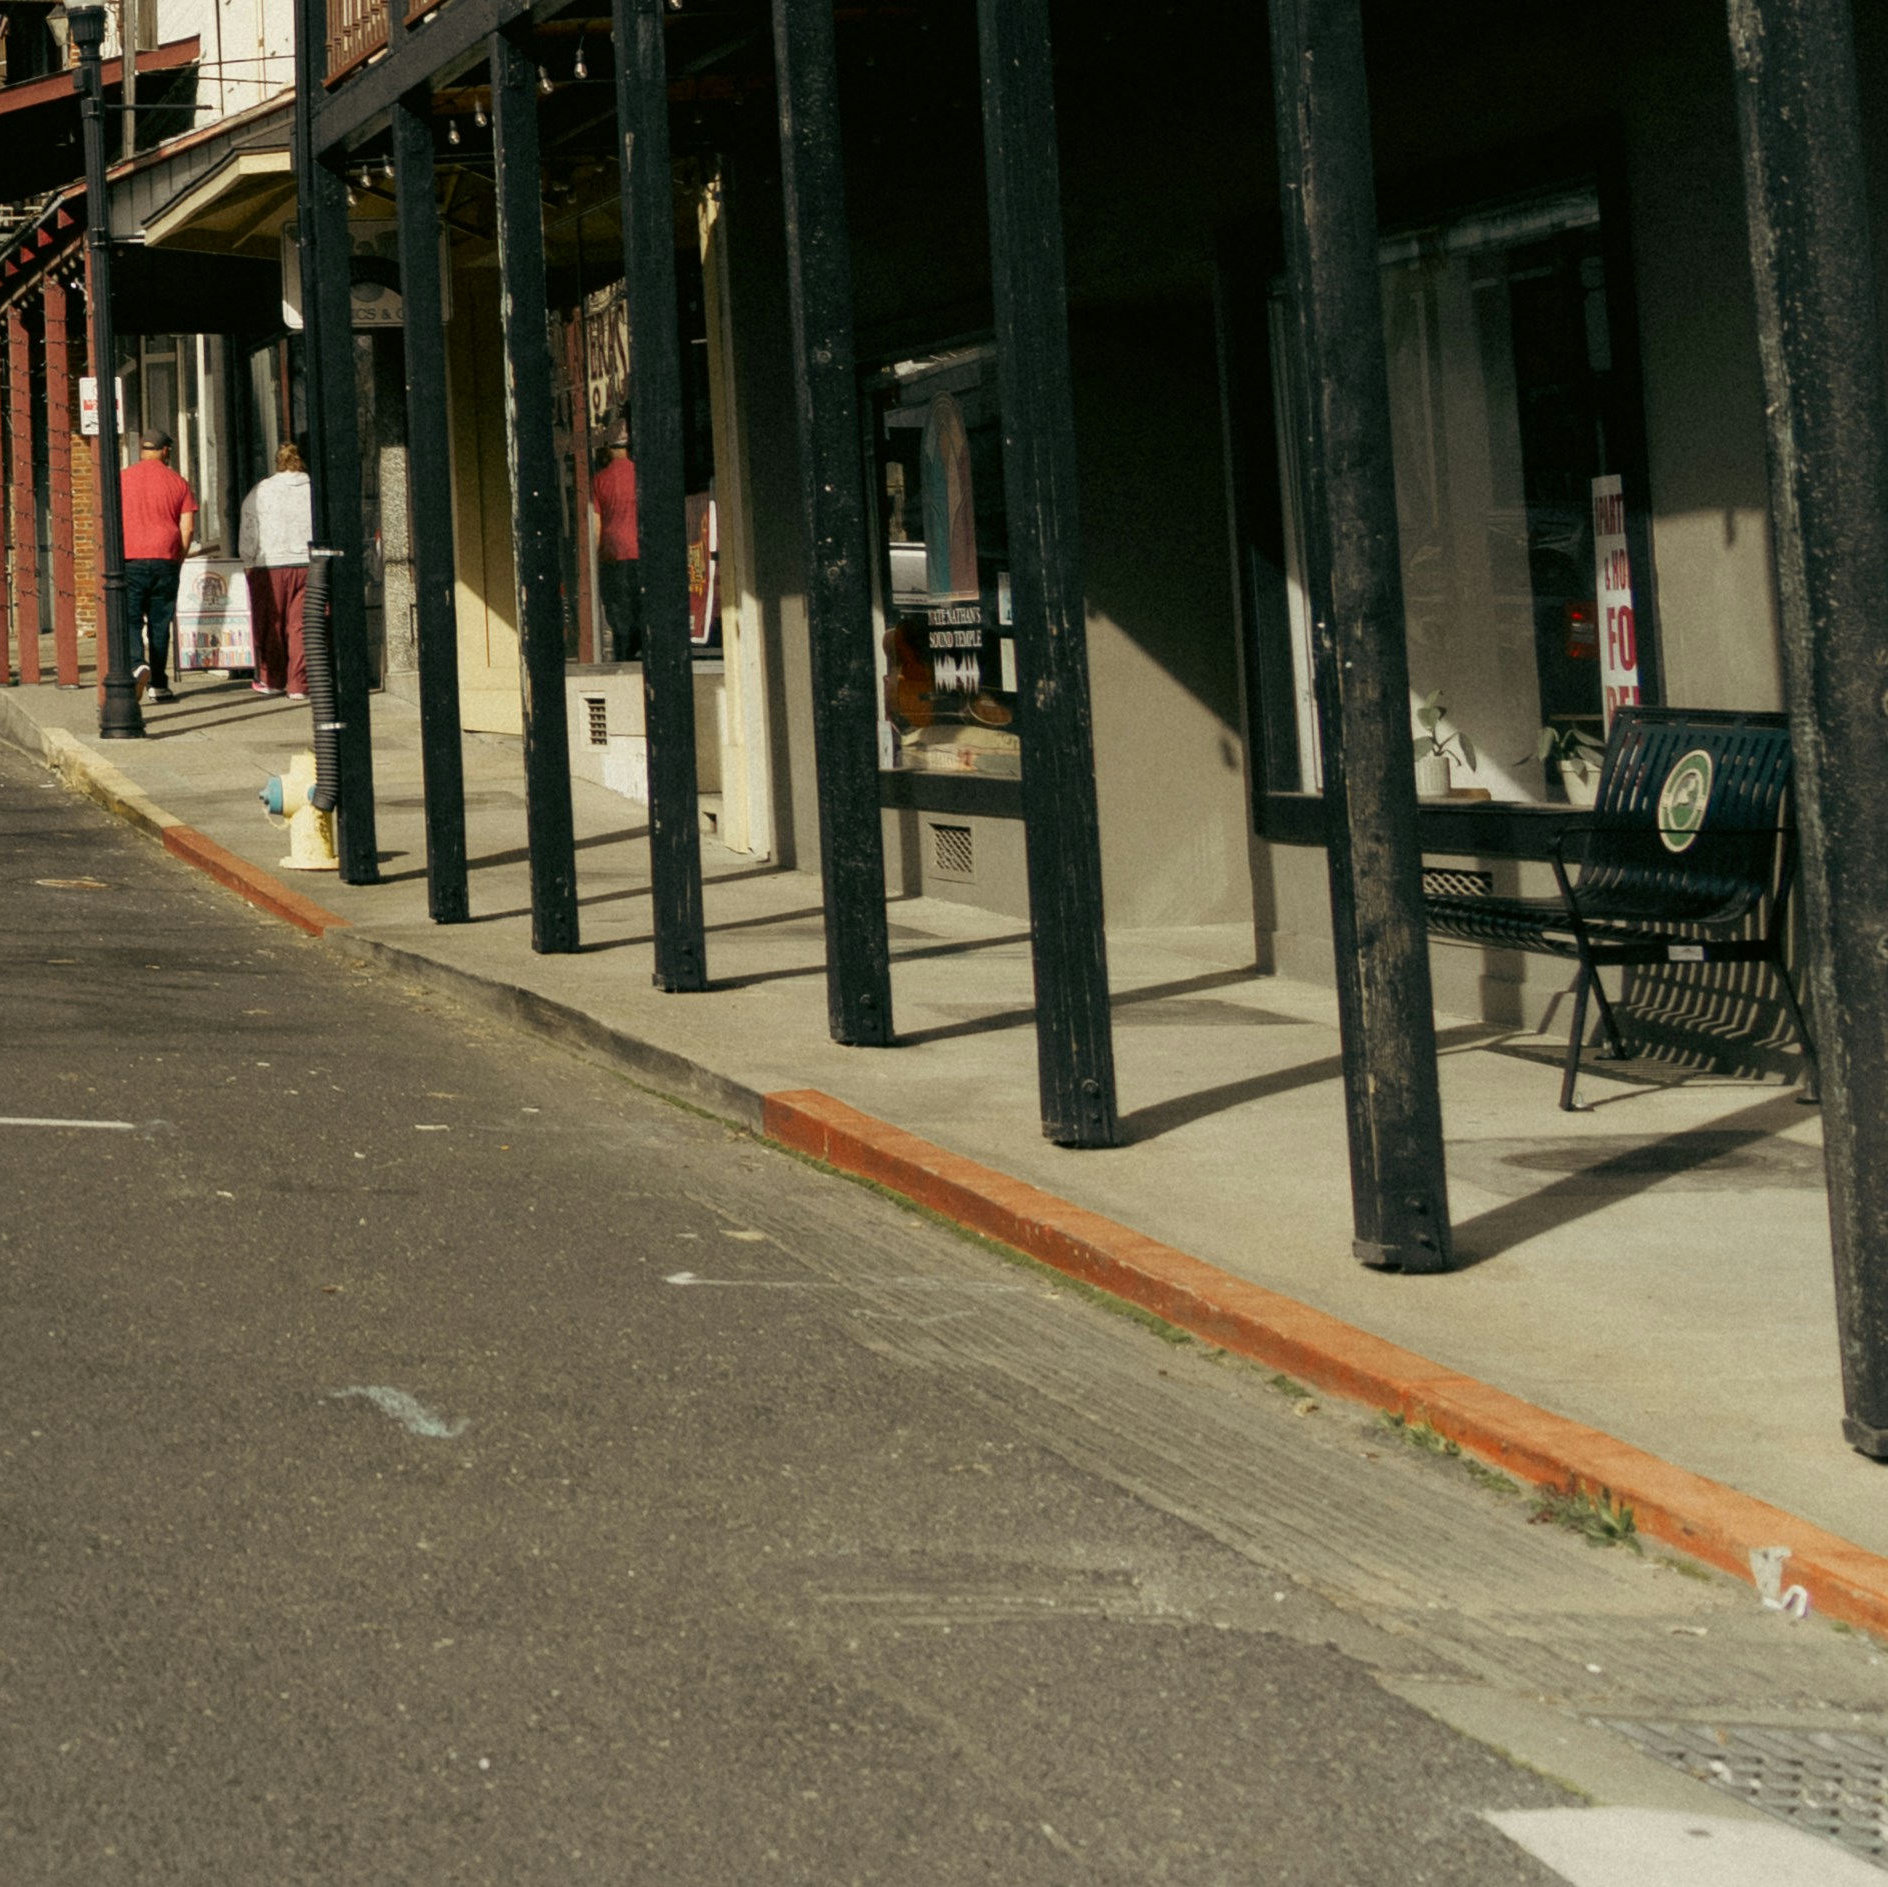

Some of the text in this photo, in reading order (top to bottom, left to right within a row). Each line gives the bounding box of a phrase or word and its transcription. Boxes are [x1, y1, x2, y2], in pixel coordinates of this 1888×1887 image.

[947, 606, 981, 626] NATHAN'S
[929, 629, 983, 648] SOUND TEMPLE
